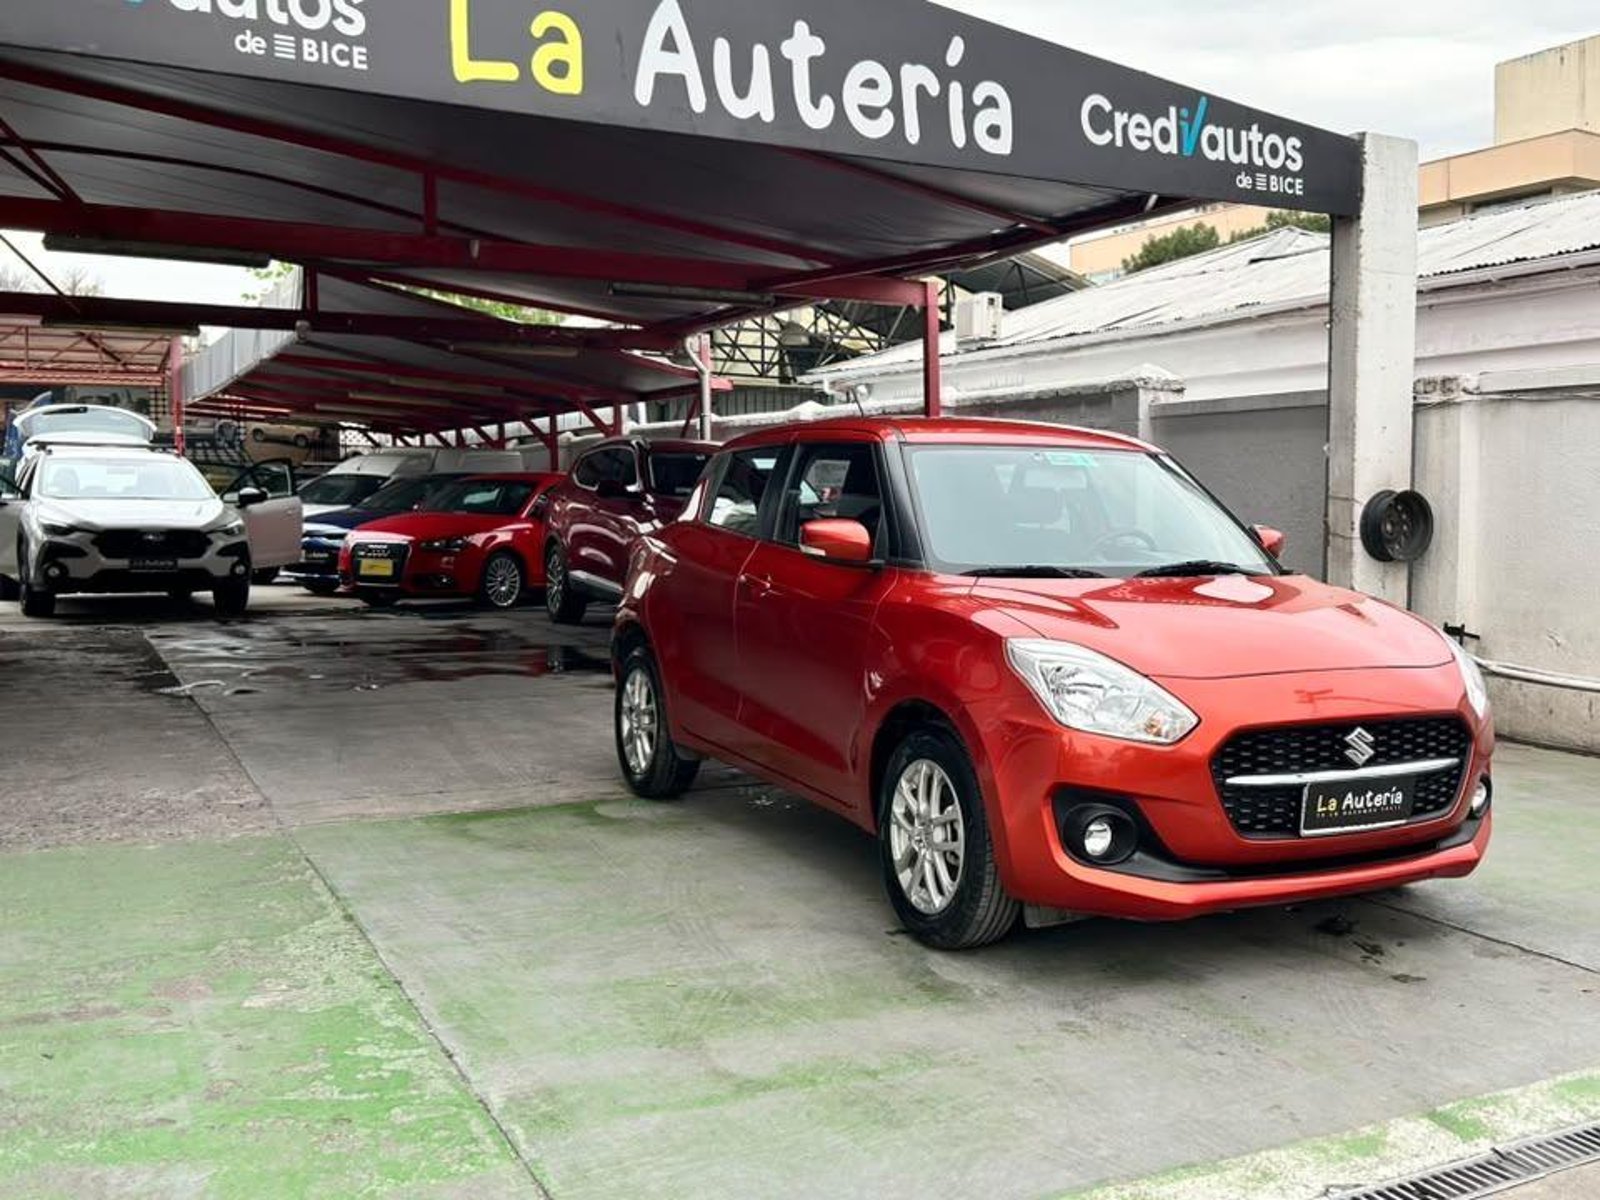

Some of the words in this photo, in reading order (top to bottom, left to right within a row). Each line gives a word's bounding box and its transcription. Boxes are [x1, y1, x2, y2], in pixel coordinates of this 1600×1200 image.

[234, 29, 267, 55] de
[302, 37, 369, 71] BICE
[450, 0, 583, 95] La
[635, 0, 1012, 156] Autería
[1236, 171, 1252, 190] de
[1269, 177, 1304, 196] BICE
[1317, 794, 1338, 813] La
[1341, 786, 1403, 811] Autería
